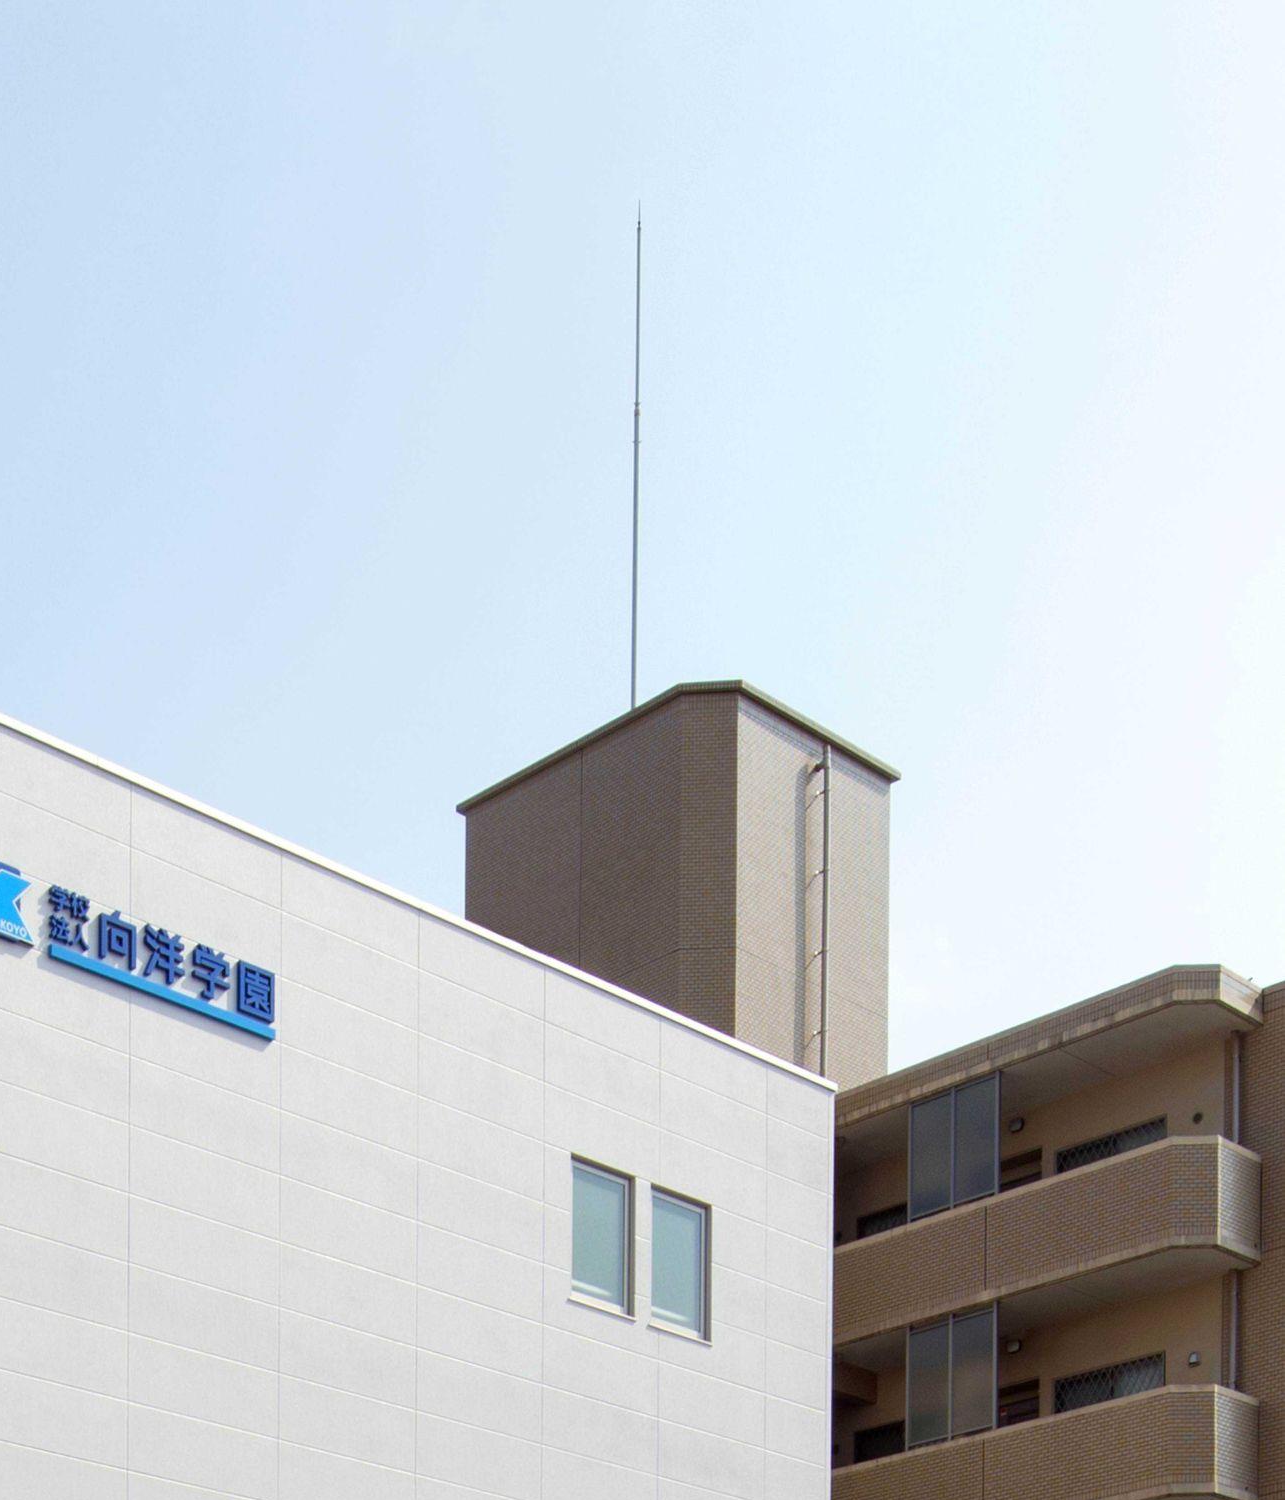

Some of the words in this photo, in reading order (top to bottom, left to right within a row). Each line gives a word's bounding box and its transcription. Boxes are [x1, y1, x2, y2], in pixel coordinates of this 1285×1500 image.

[48, 884, 89, 922] 学校
[0, 920, 27, 937] KOYO
[48, 915, 89, 951] 法人
[98, 910, 275, 1024] 向洋学園
